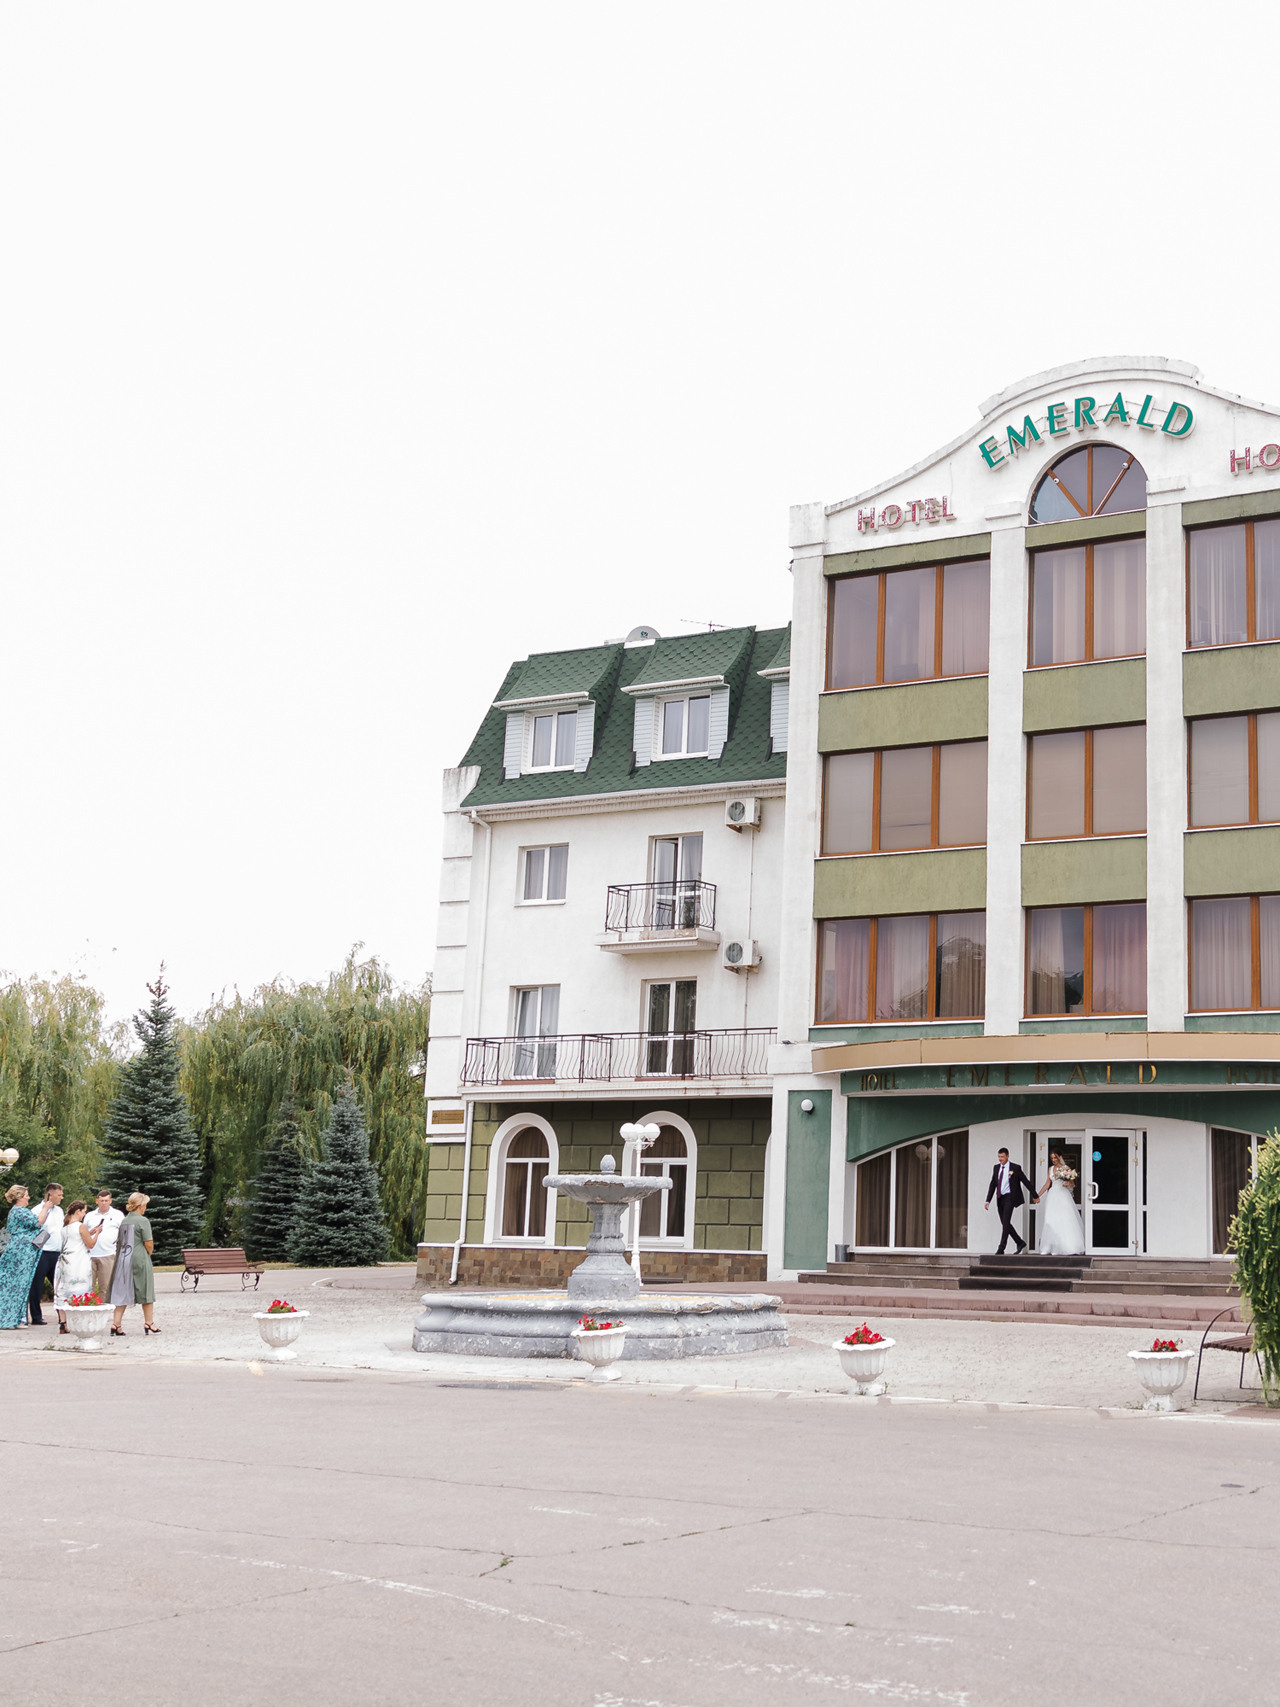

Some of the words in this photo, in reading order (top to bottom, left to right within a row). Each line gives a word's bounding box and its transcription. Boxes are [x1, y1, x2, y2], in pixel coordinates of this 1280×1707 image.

[979, 392, 1195, 470] EMERALD
[857, 495, 955, 532] HOTEL
[860, 1072, 899, 1091] HOTEL
[946, 1063, 1157, 1088] EMERALD
